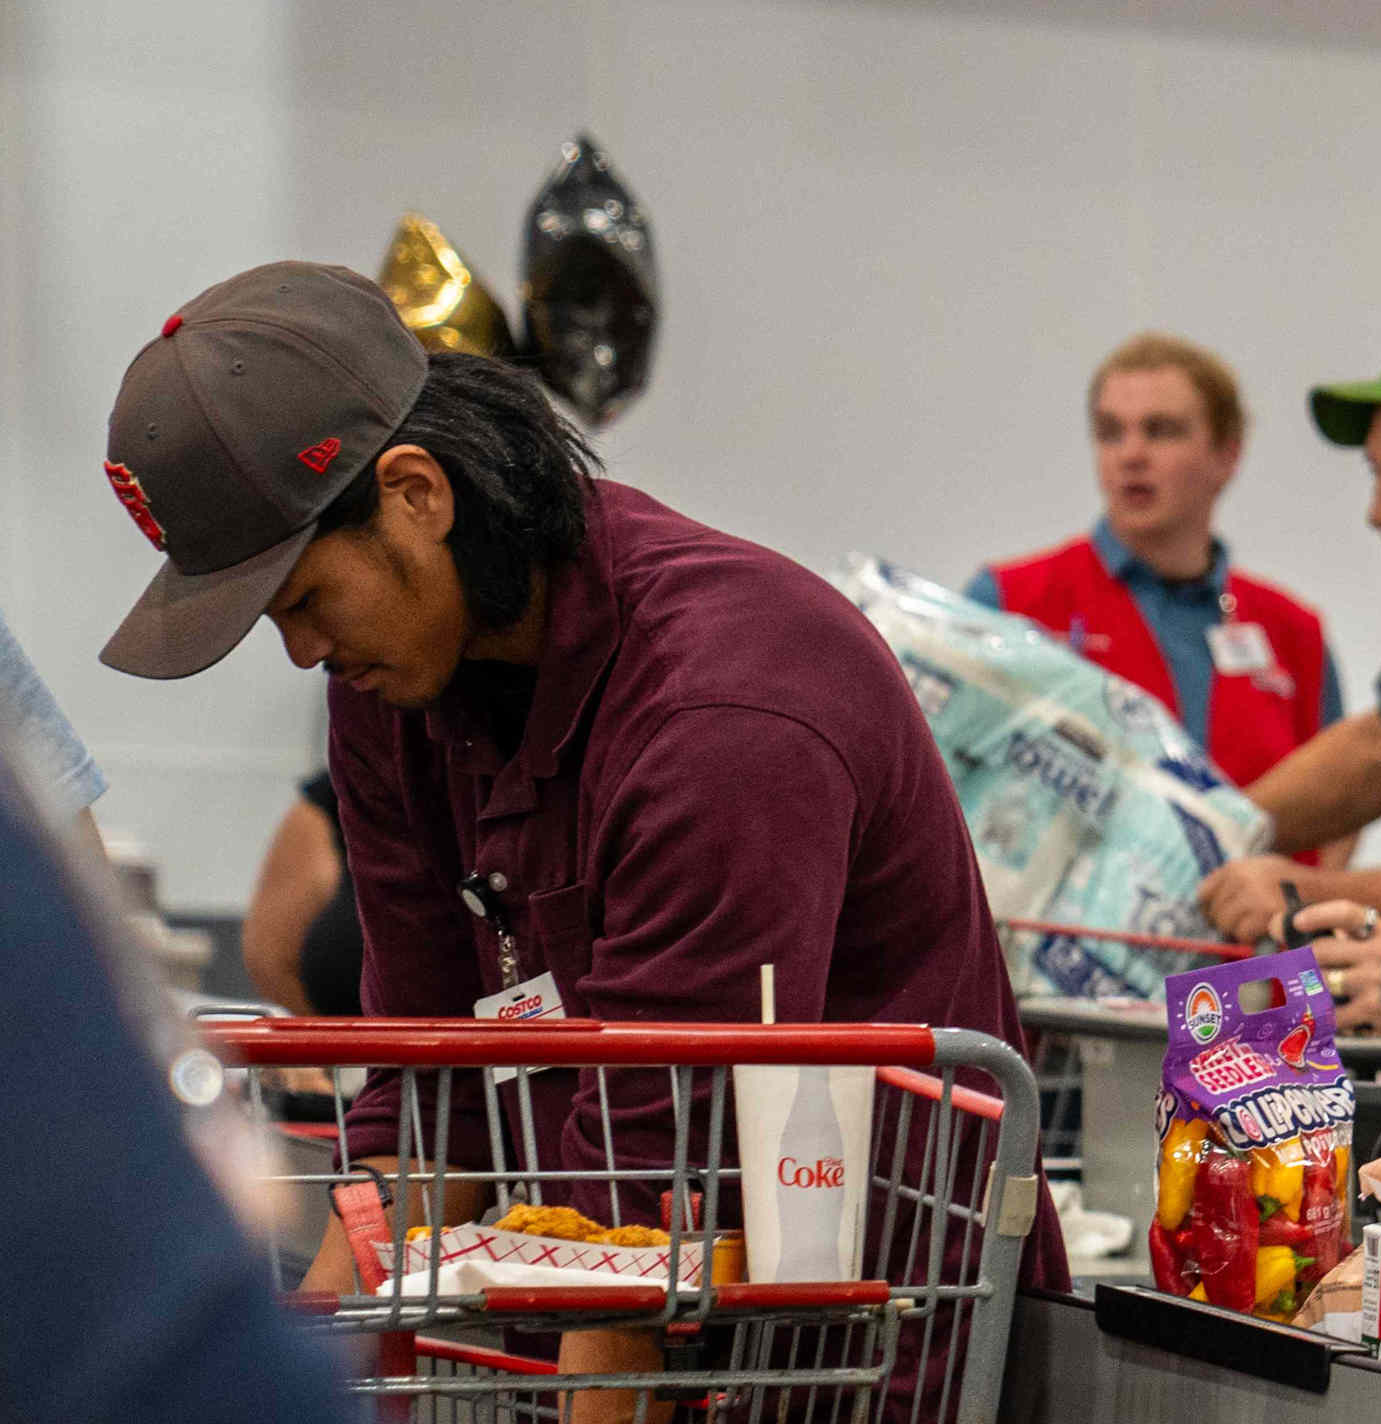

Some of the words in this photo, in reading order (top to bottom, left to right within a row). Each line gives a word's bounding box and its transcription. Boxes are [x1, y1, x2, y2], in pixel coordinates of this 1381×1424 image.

[498, 995, 542, 1020] COSTCO
[1188, 1014, 1221, 1029] SUNSET
[777, 1157, 845, 1188] Coke
